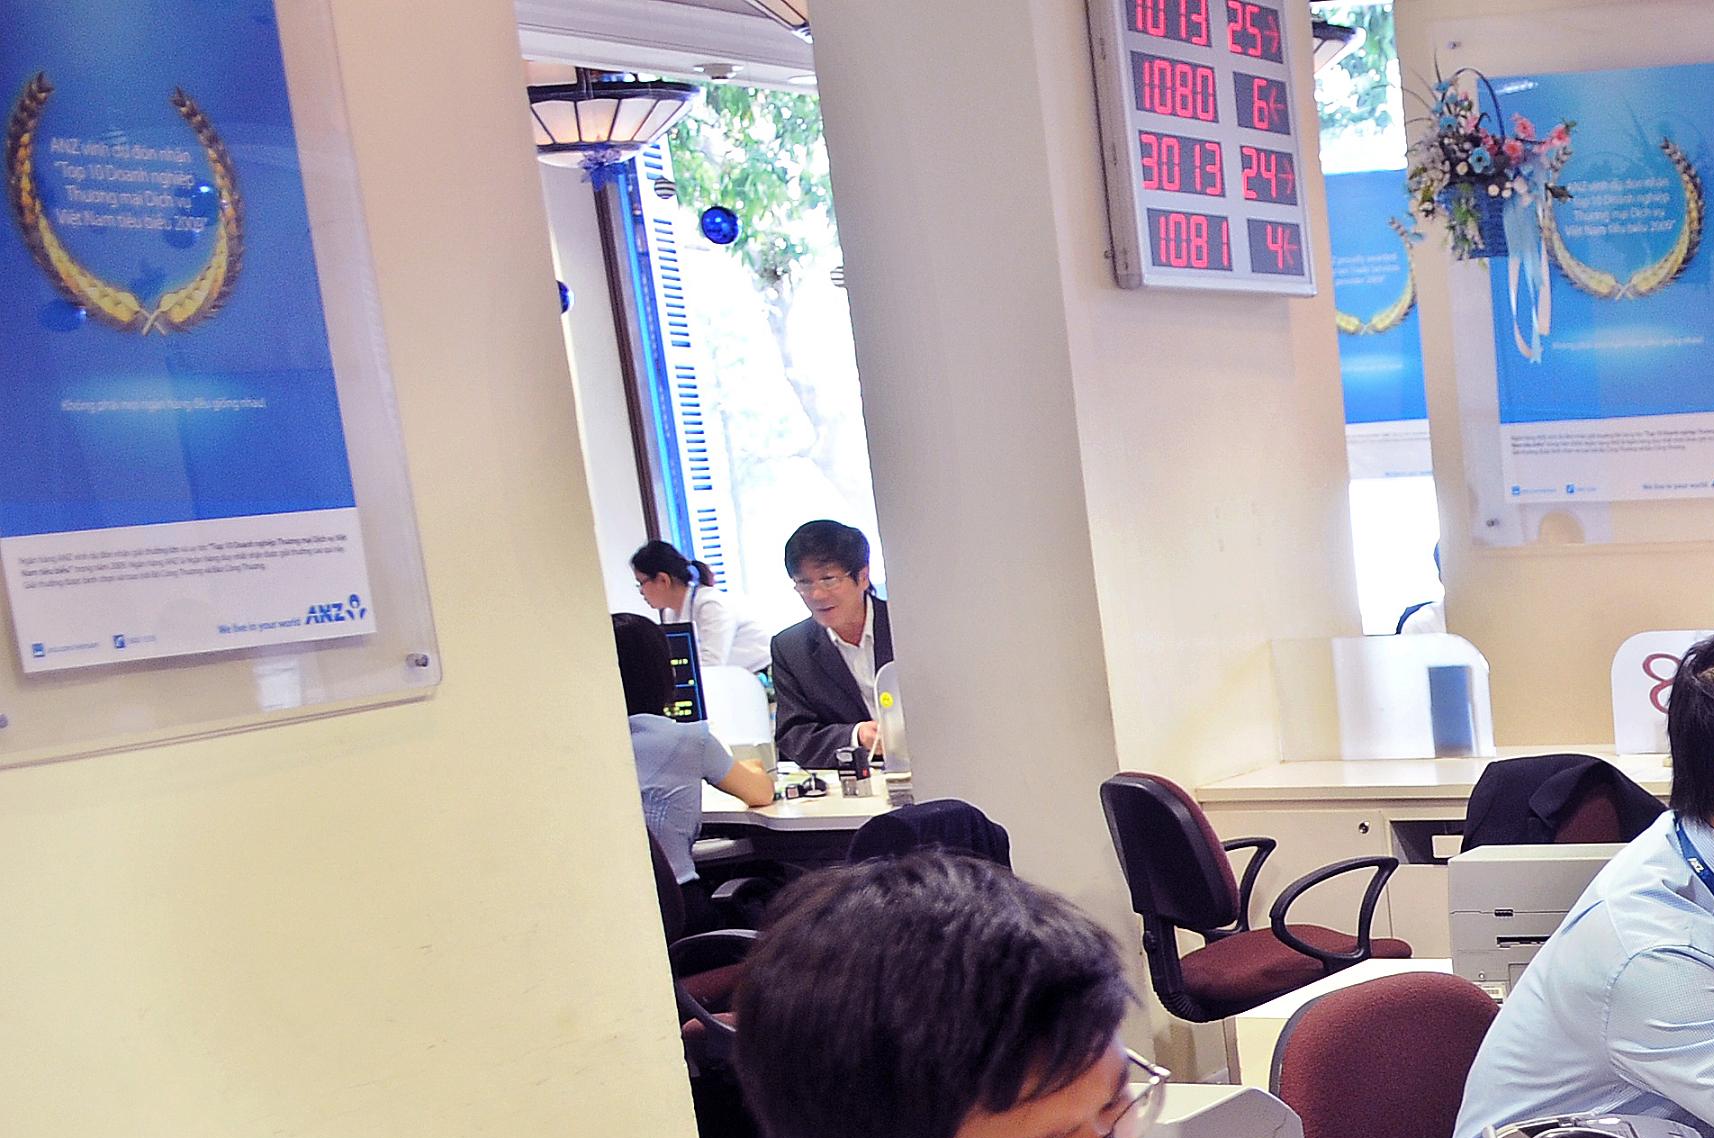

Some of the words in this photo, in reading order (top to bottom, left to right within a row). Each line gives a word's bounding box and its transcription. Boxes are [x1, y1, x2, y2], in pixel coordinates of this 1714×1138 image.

[1226, 0, 1262, 57] 25
[1142, 60, 1216, 122] 1080
[1252, 77, 1269, 130] 6
[1141, 133, 1223, 197] 3013
[1241, 145, 1278, 200] 24
[1158, 212, 1231, 269] 1081
[1266, 223, 1284, 270] 4
[305, 602, 346, 625] ANZ
